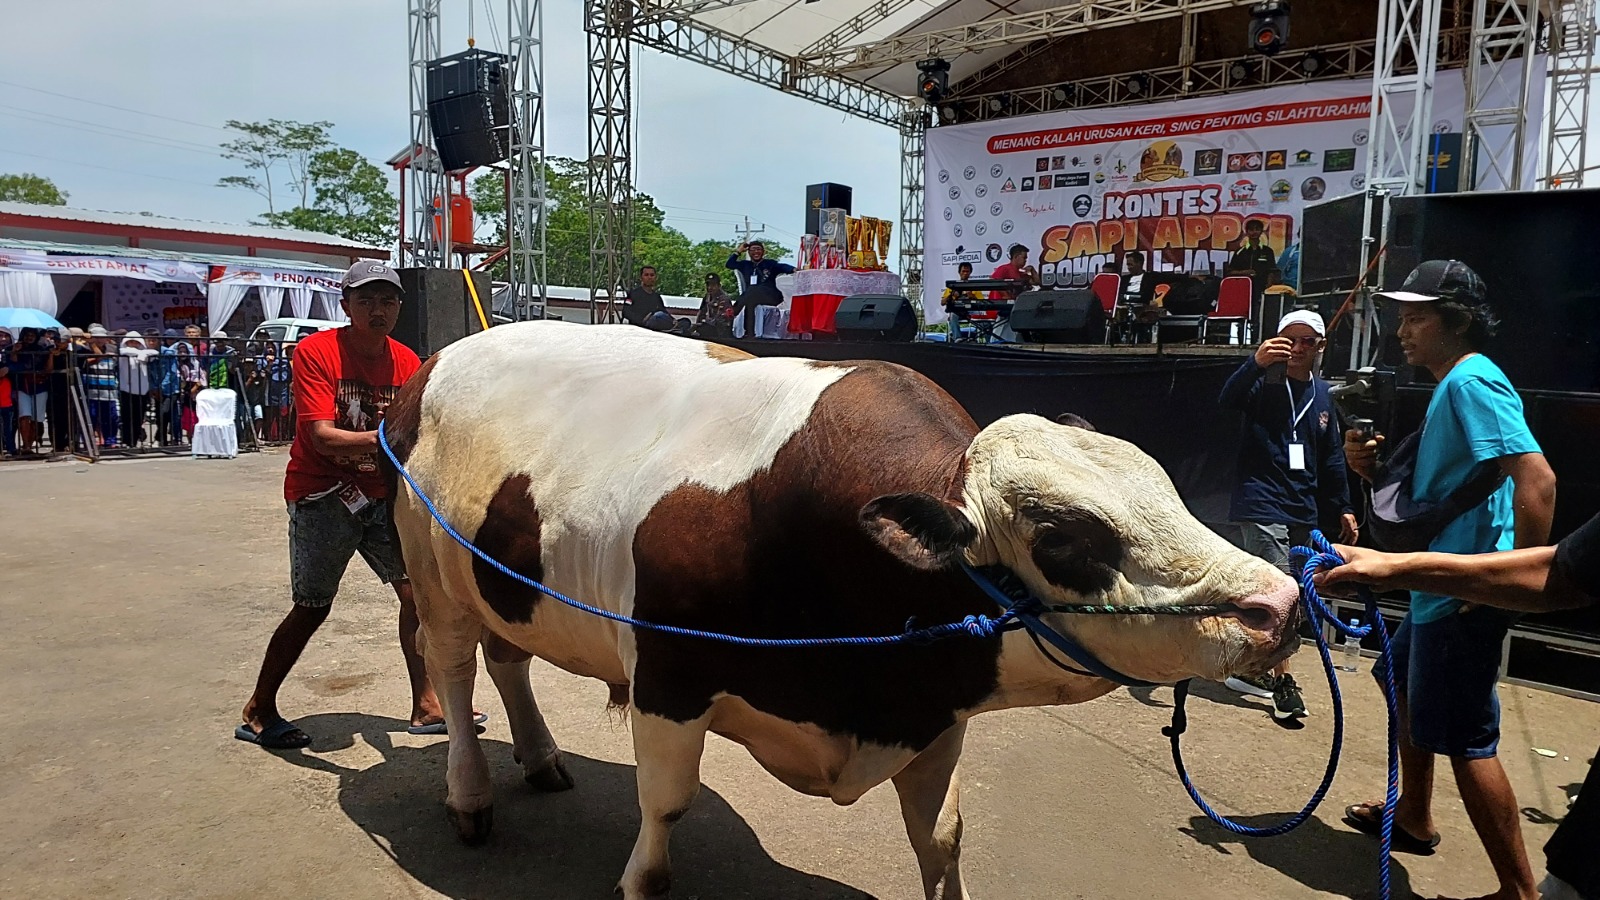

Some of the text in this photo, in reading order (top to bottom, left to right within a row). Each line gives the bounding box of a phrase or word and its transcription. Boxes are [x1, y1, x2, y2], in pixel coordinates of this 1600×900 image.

[993, 101, 1373, 150] MENANG KALAH URUSAN KERI, SING PENTING SILAHTURAHM
[1105, 187, 1219, 220] KONTES
[1044, 219, 1138, 263] SAPI
[46, 259, 148, 274] SEKRETARIAT
[943, 253, 980, 263] SAPI PEDIA
[273, 272, 342, 290] PENDAFTAR
